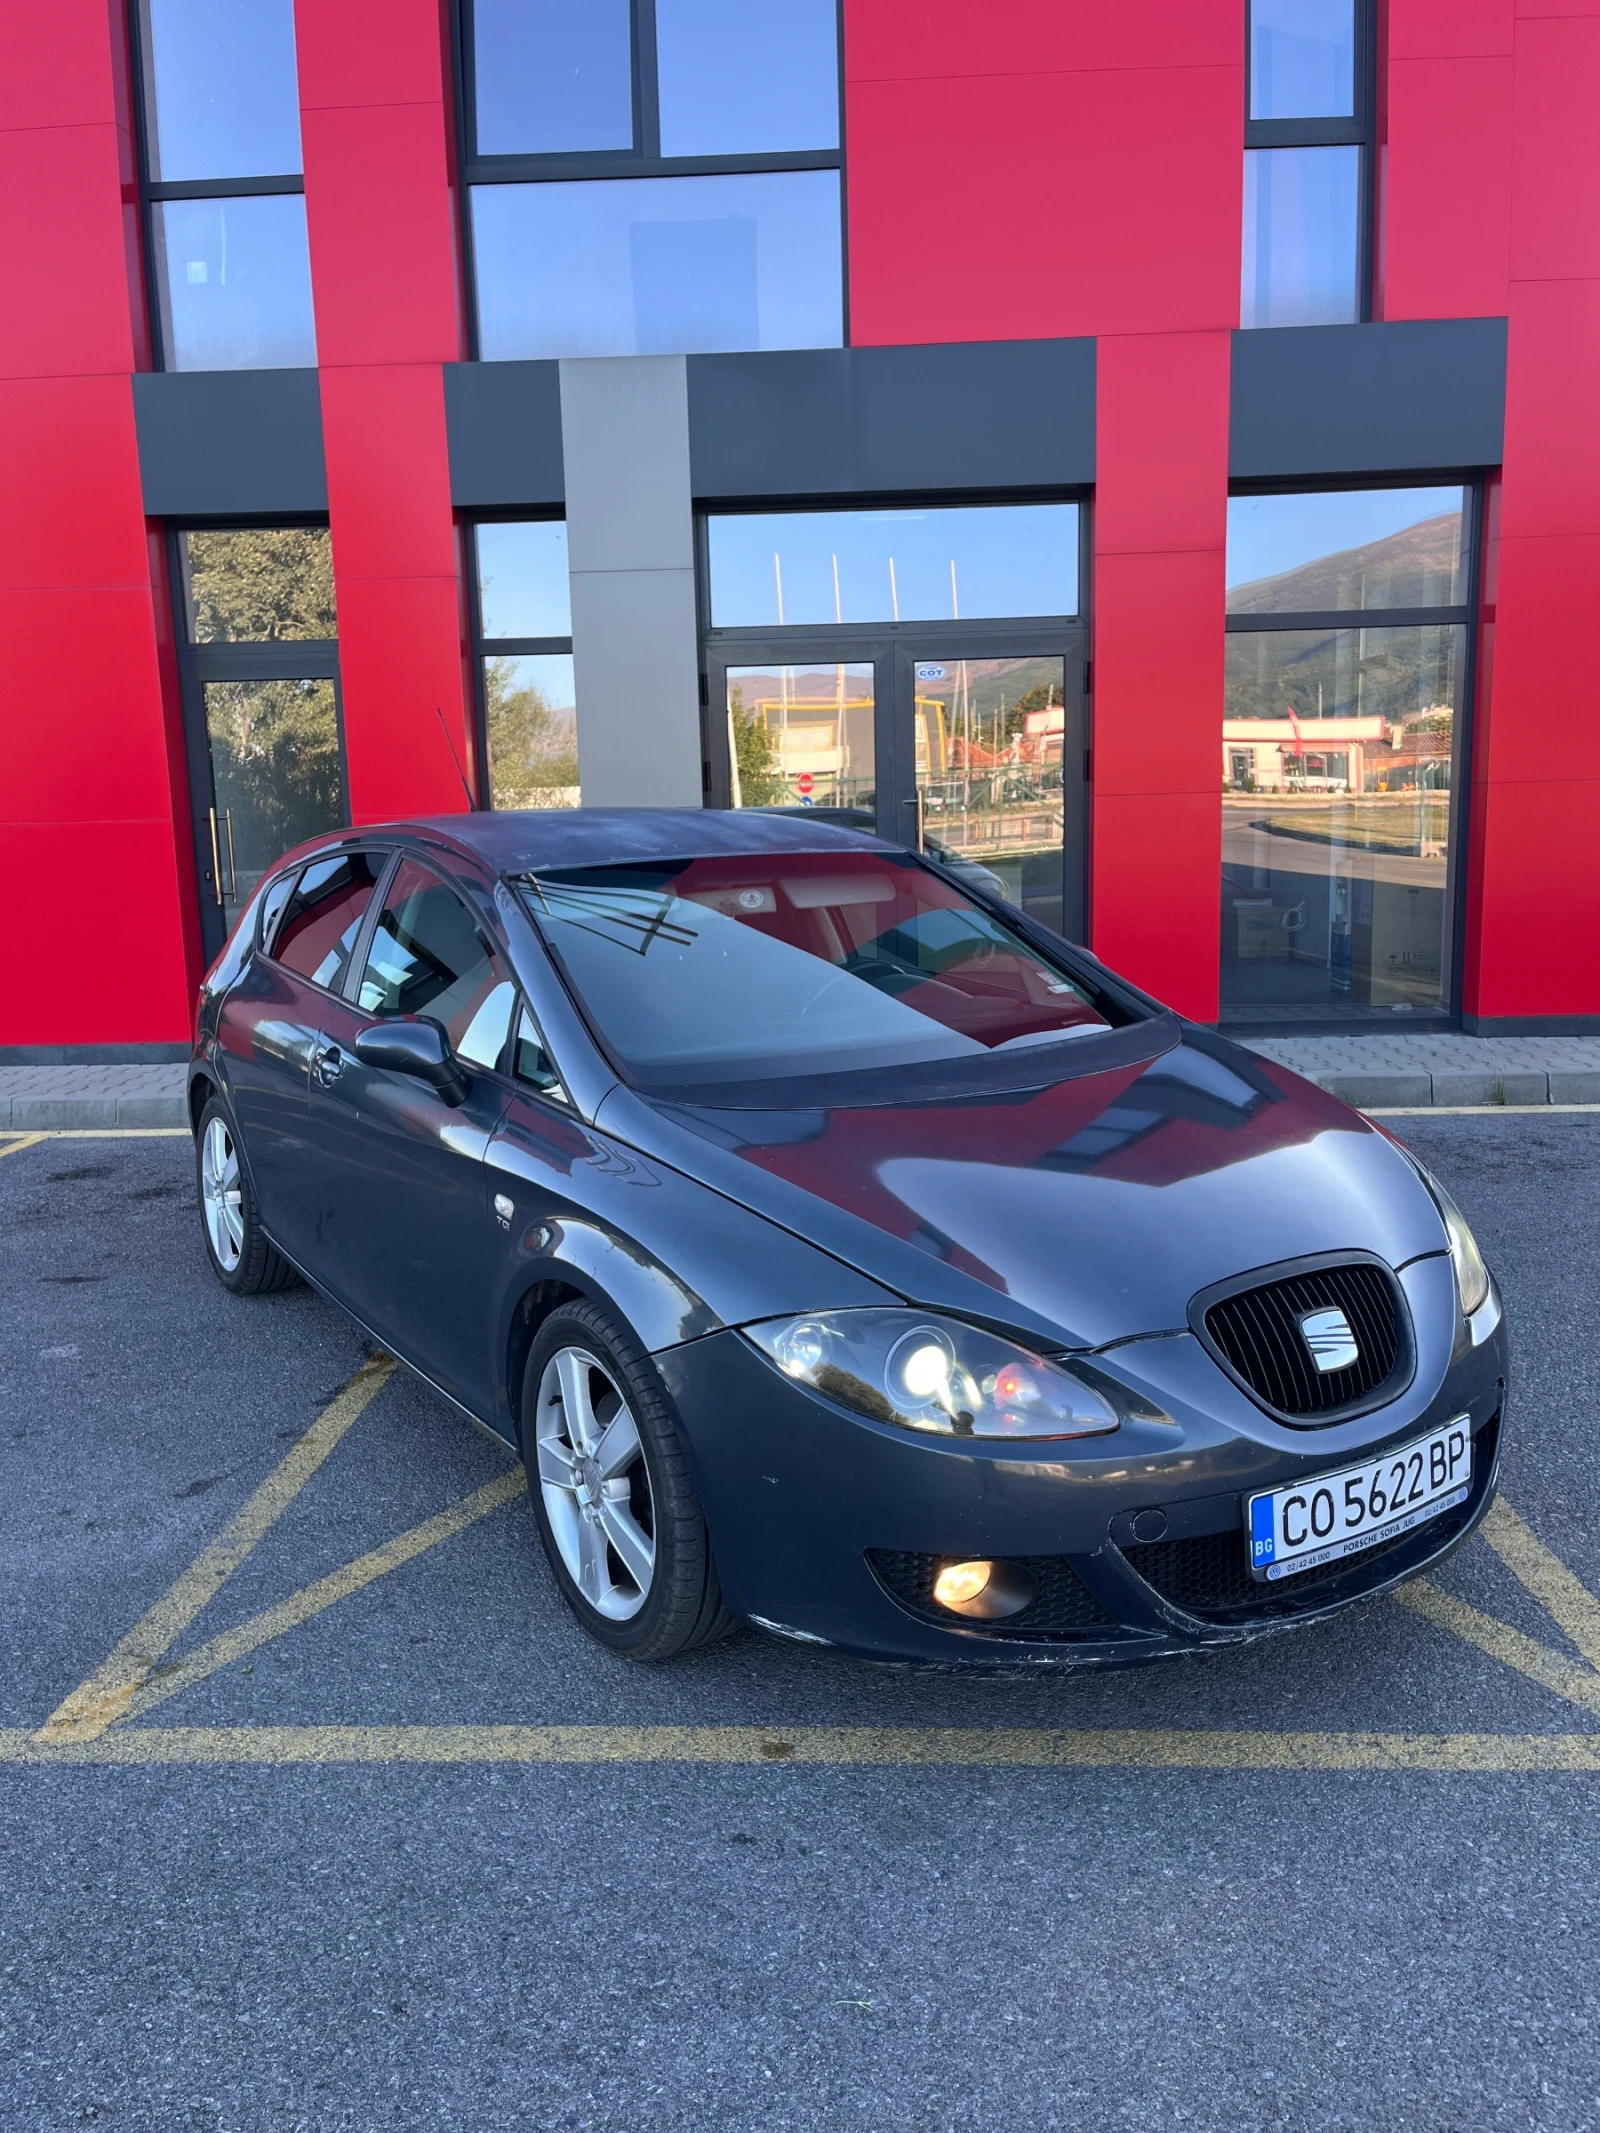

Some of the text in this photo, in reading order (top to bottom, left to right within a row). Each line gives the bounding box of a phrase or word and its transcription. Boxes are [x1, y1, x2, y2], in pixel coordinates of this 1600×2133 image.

[1282, 1431, 1464, 1547] CO 5622 BP
[1254, 1538, 1273, 1557] BG
[1343, 1516, 1415, 1553] PORSCHE SOFIA JUG
[1286, 1551, 1331, 1572] 02/42 45 000
